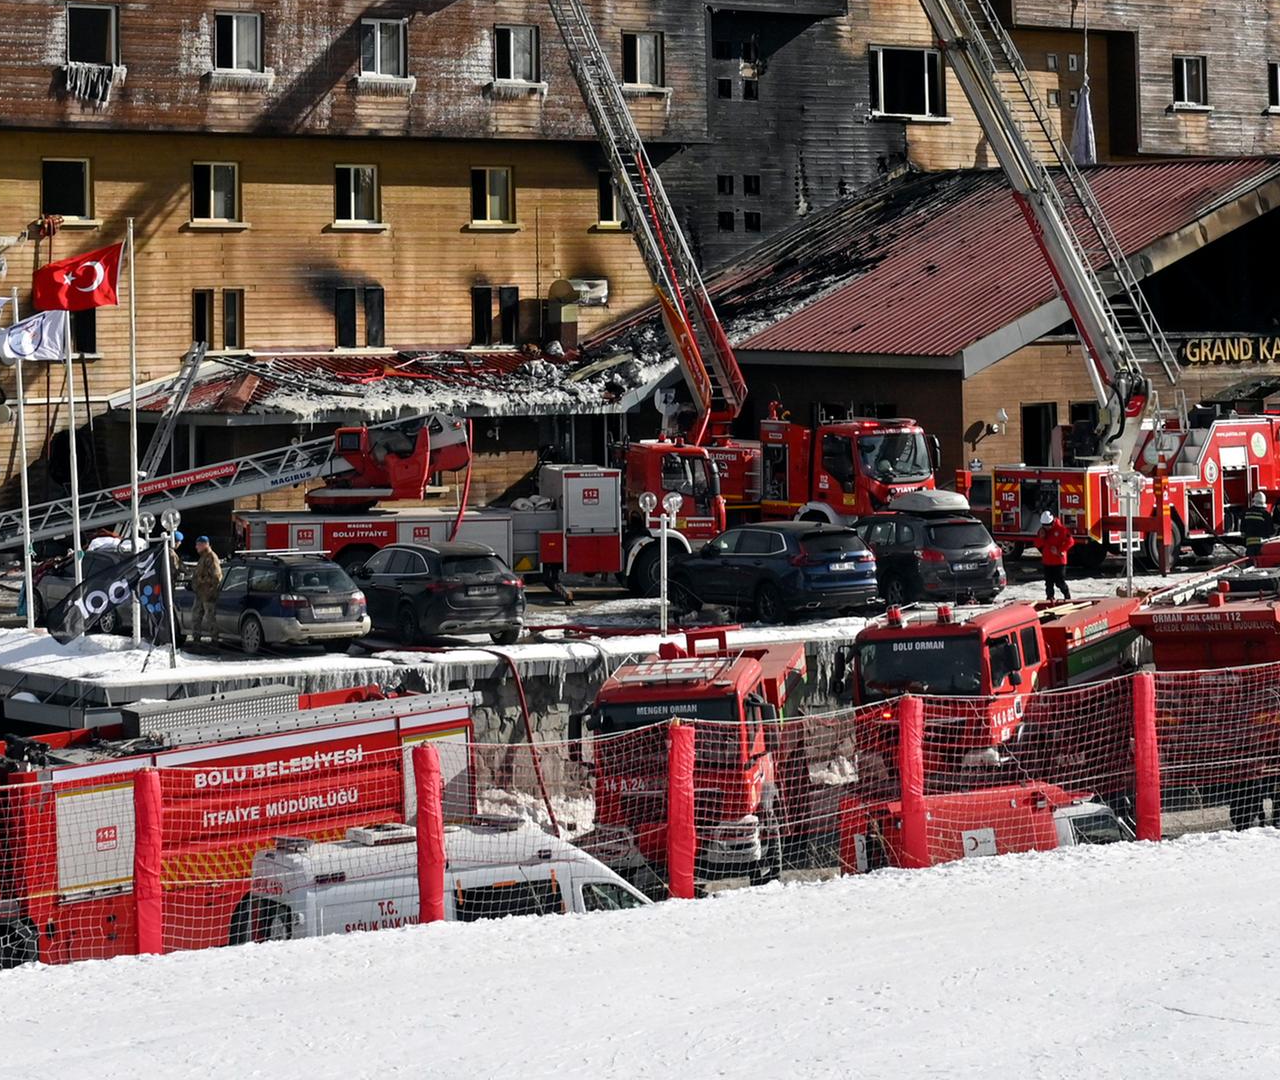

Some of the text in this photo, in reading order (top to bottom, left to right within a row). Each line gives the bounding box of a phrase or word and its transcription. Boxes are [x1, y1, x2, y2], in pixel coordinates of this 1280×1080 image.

[1186, 337, 1253, 362] GRAND
[271, 471, 312, 487] MAGIRUS
[584, 490, 598, 498] 112
[1002, 492, 1015, 502] 112
[1066, 494, 1079, 504] 112
[298, 530, 312, 538] 112
[357, 529, 388, 538] İTFAİYE
[414, 528, 428, 536] 112
[1152, 613, 1182, 623] ORMAN
[1226, 612, 1241, 621] 112
[893, 641, 945, 651] BOLU ORMAN
[636, 704, 697, 716] MENGEN ORMAN
[194, 744, 363, 789] BOLU BELEDİYESİ
[203, 788, 359, 828] İTFAİYE MÜDÜRLÜĞÜ
[97, 828, 115, 840] 112
[378, 901, 398, 917] T.C.
